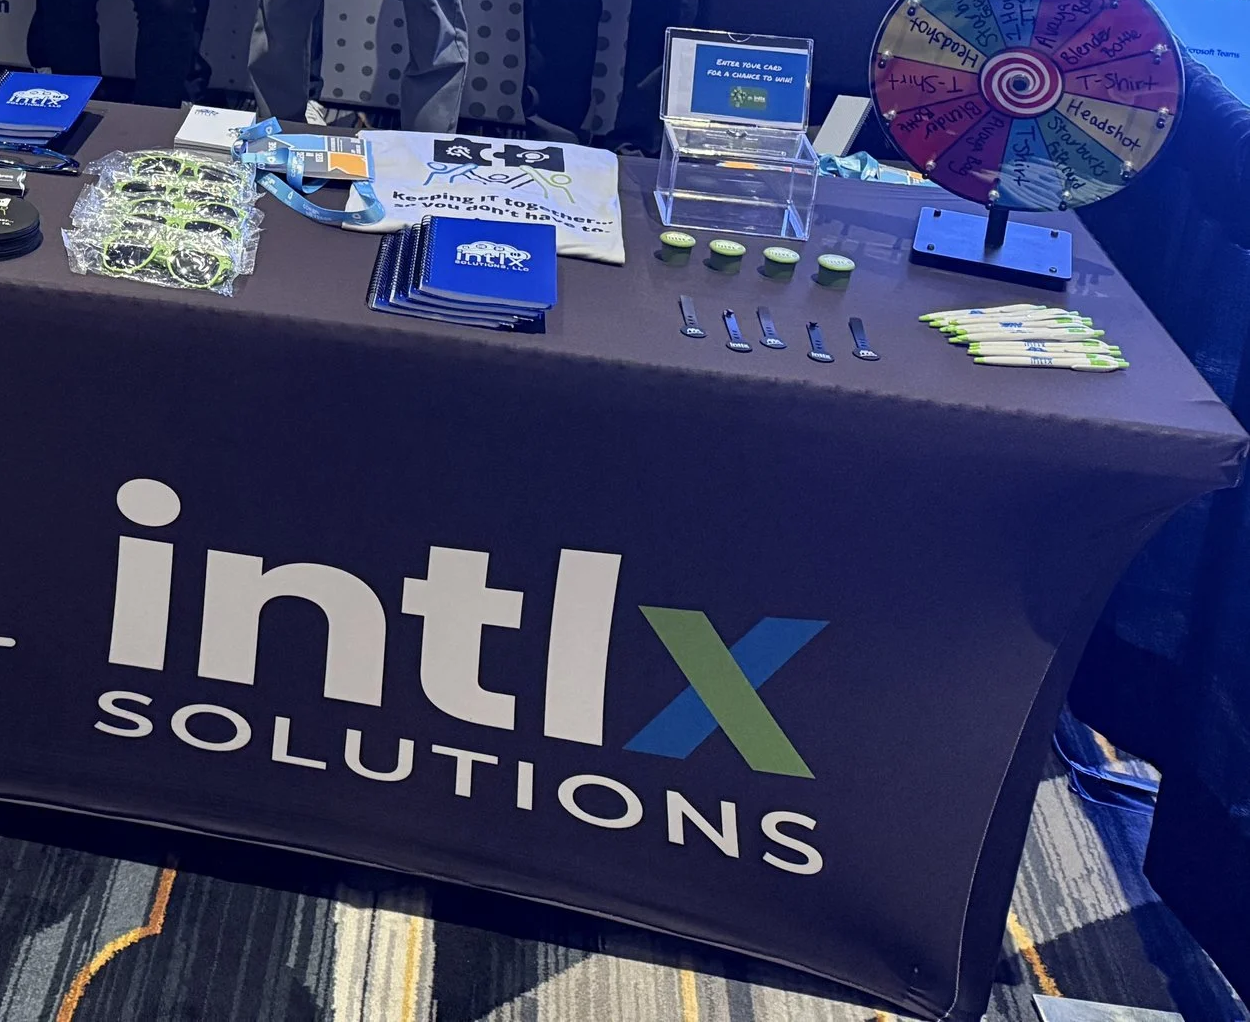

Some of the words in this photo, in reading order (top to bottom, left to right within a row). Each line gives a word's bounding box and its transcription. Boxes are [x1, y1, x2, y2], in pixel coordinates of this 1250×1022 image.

[910, 16, 980, 69] Headshot
[1060, 25, 1112, 66] Blender
[1216, 48, 1240, 58] Teams
[716, 58, 740, 68] ENTER
[742, 62, 762, 71] YOUR
[764, 64, 782, 72] CARD
[732, 72, 760, 80] CHANCE
[775, 76, 793, 84] WIN!
[1076, 72, 1160, 94] T-Shirt
[925, 101, 982, 139] Blender
[1066, 98, 1142, 152] Headshot
[1047, 116, 1110, 177] Starbucks
[392, 191, 475, 205] Keeping
[480, 195, 499, 203] IT
[422, 201, 460, 211] you
[525, 211, 576, 229] have
[109, 479, 831, 779] intlx
[95, 688, 827, 876] SOLUTIONS
